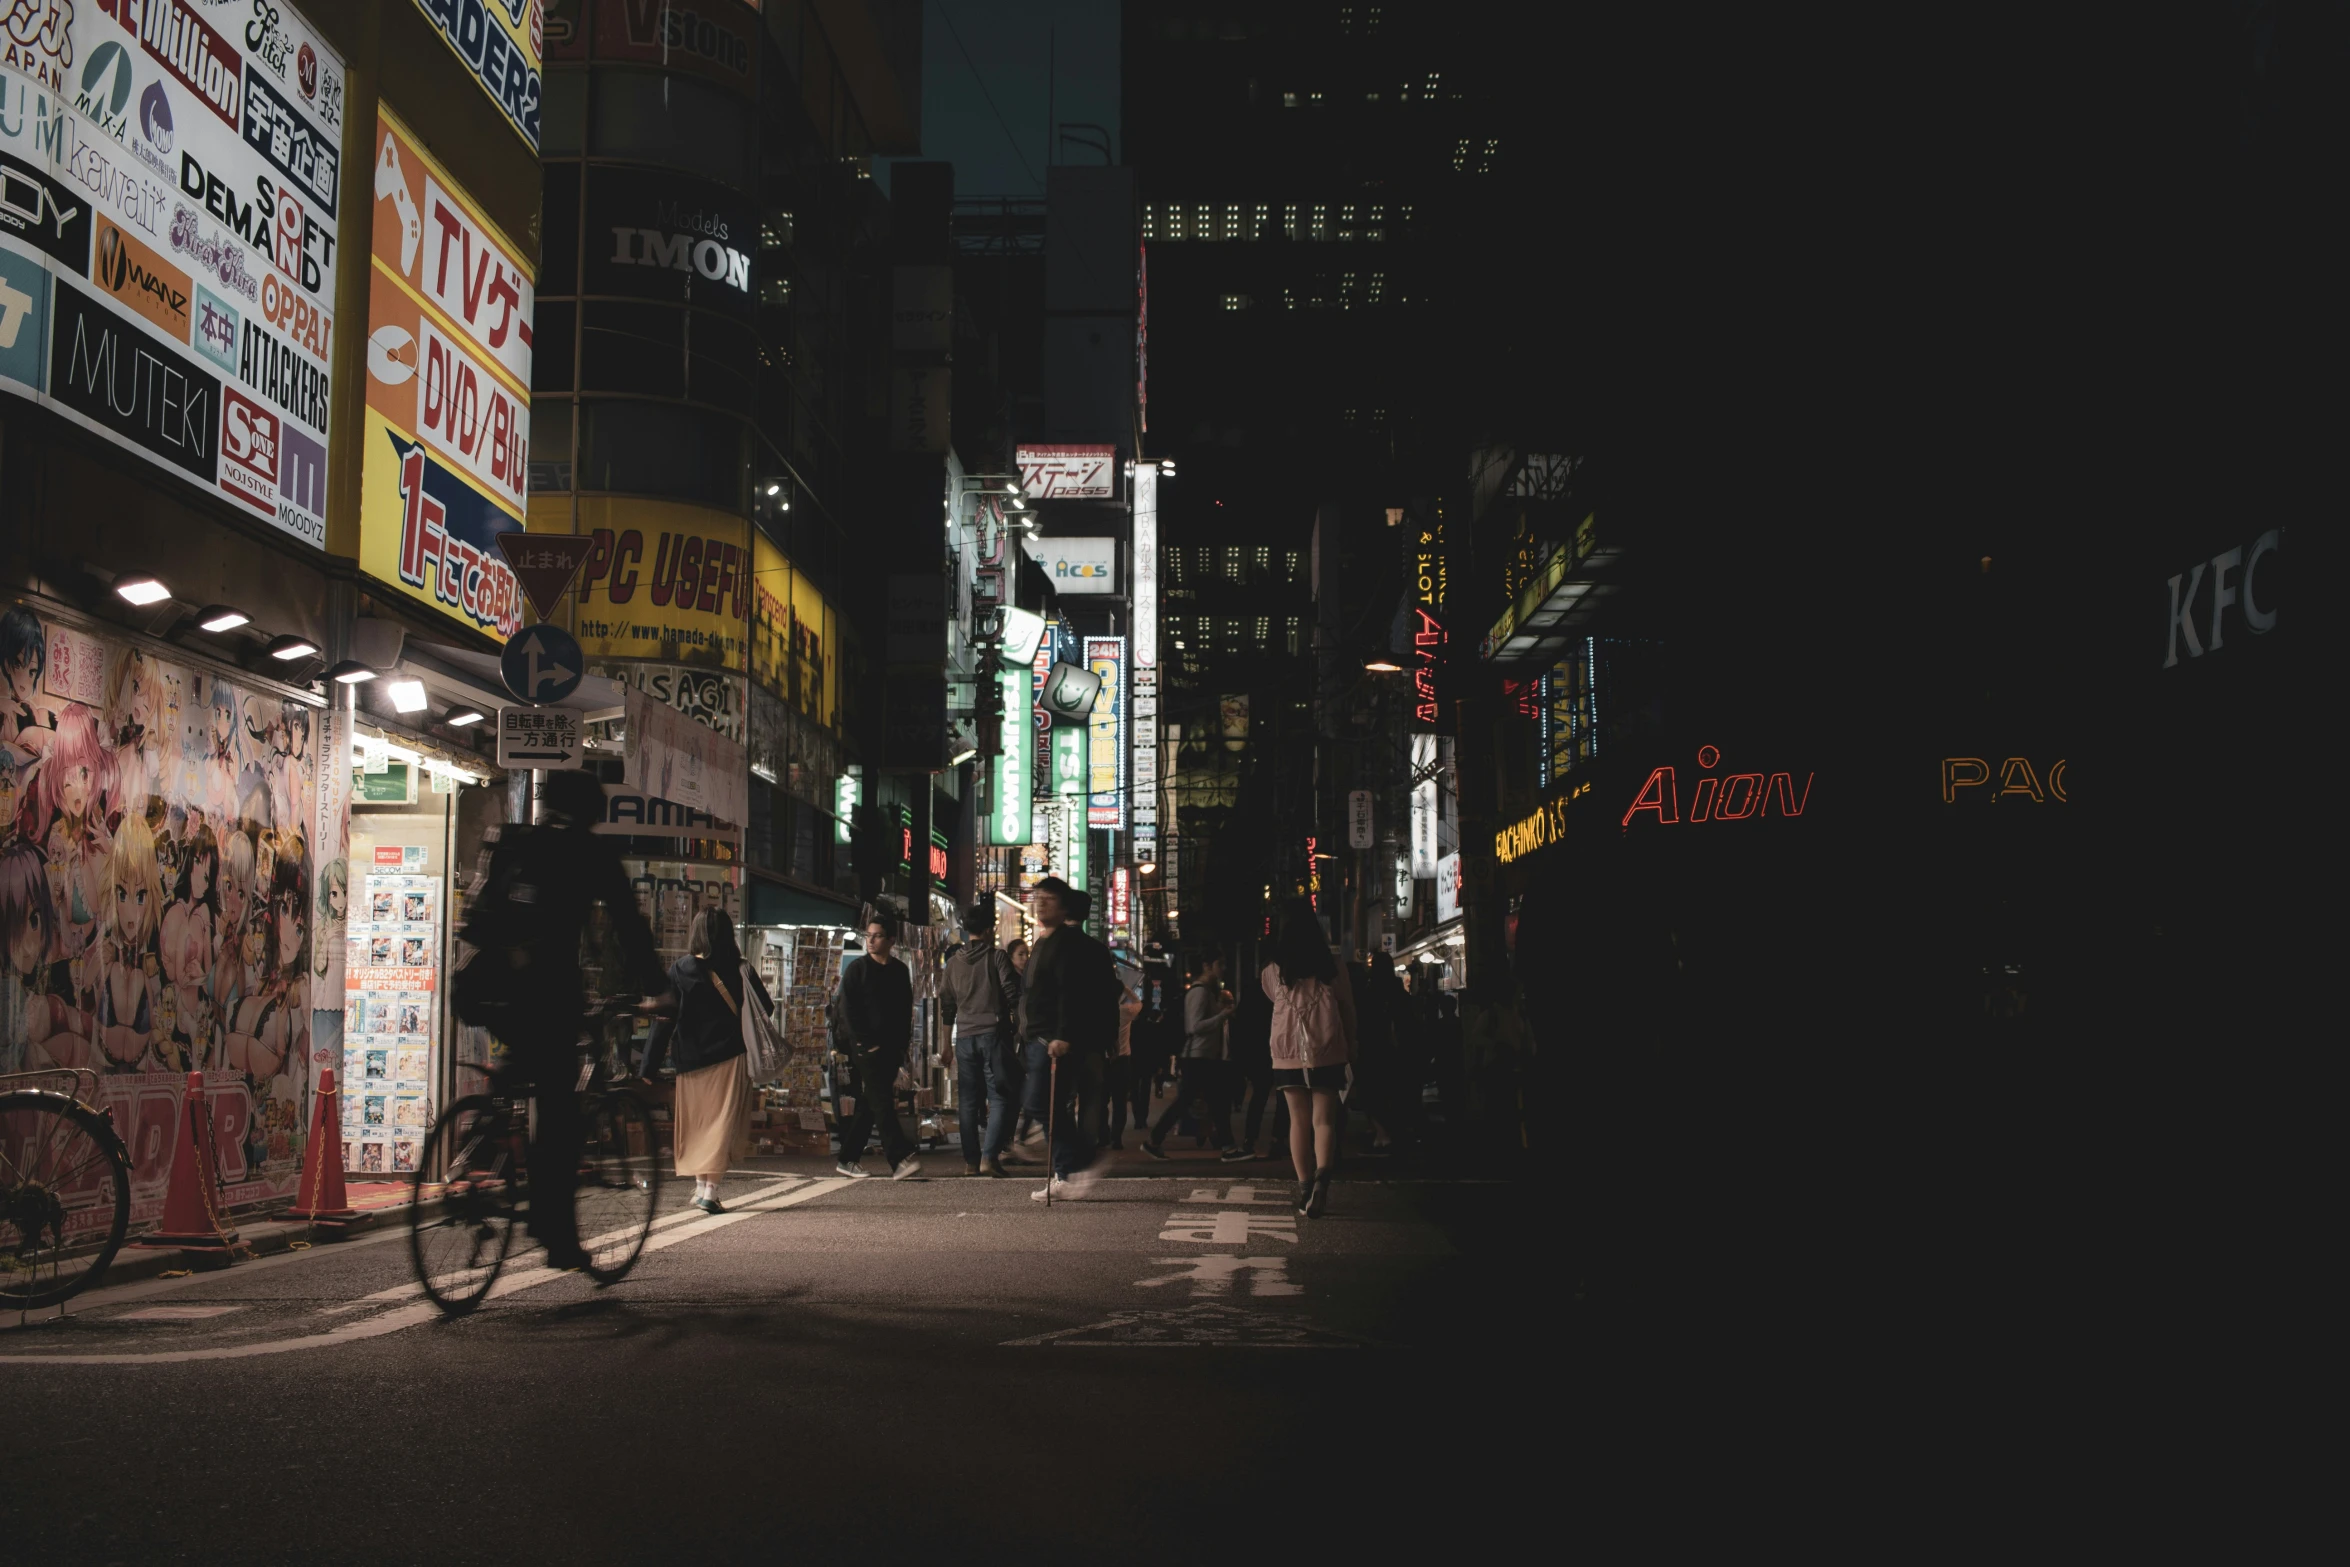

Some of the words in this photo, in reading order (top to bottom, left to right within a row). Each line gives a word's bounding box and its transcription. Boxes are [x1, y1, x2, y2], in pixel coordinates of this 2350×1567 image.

[246, 80, 337, 207] 宇宙企画
[657, 200, 729, 242] Models
[127, 257, 188, 318] WANZ
[610, 226, 750, 293] IMON
[200, 301, 235, 354] 本中
[261, 273, 332, 363] OPPAI
[69, 313, 208, 459] MUTEKI
[240, 317, 329, 435] ATTACKERS
[278, 502, 324, 542] MOODYZ
[1050, 486, 1111, 499] pass
[518, 551, 575, 570] 止まれ
[578, 528, 644, 604] PC
[2162, 528, 2280, 671] KFC
[1089, 644, 1119, 658] 24H
[505, 714, 576, 730] 自転車を除く
[505, 731, 577, 748] 一方通行
[1001, 670, 1021, 843] TSUKUMO
[1621, 745, 1815, 826] Aion
[374, 866, 401, 875] SECOM
